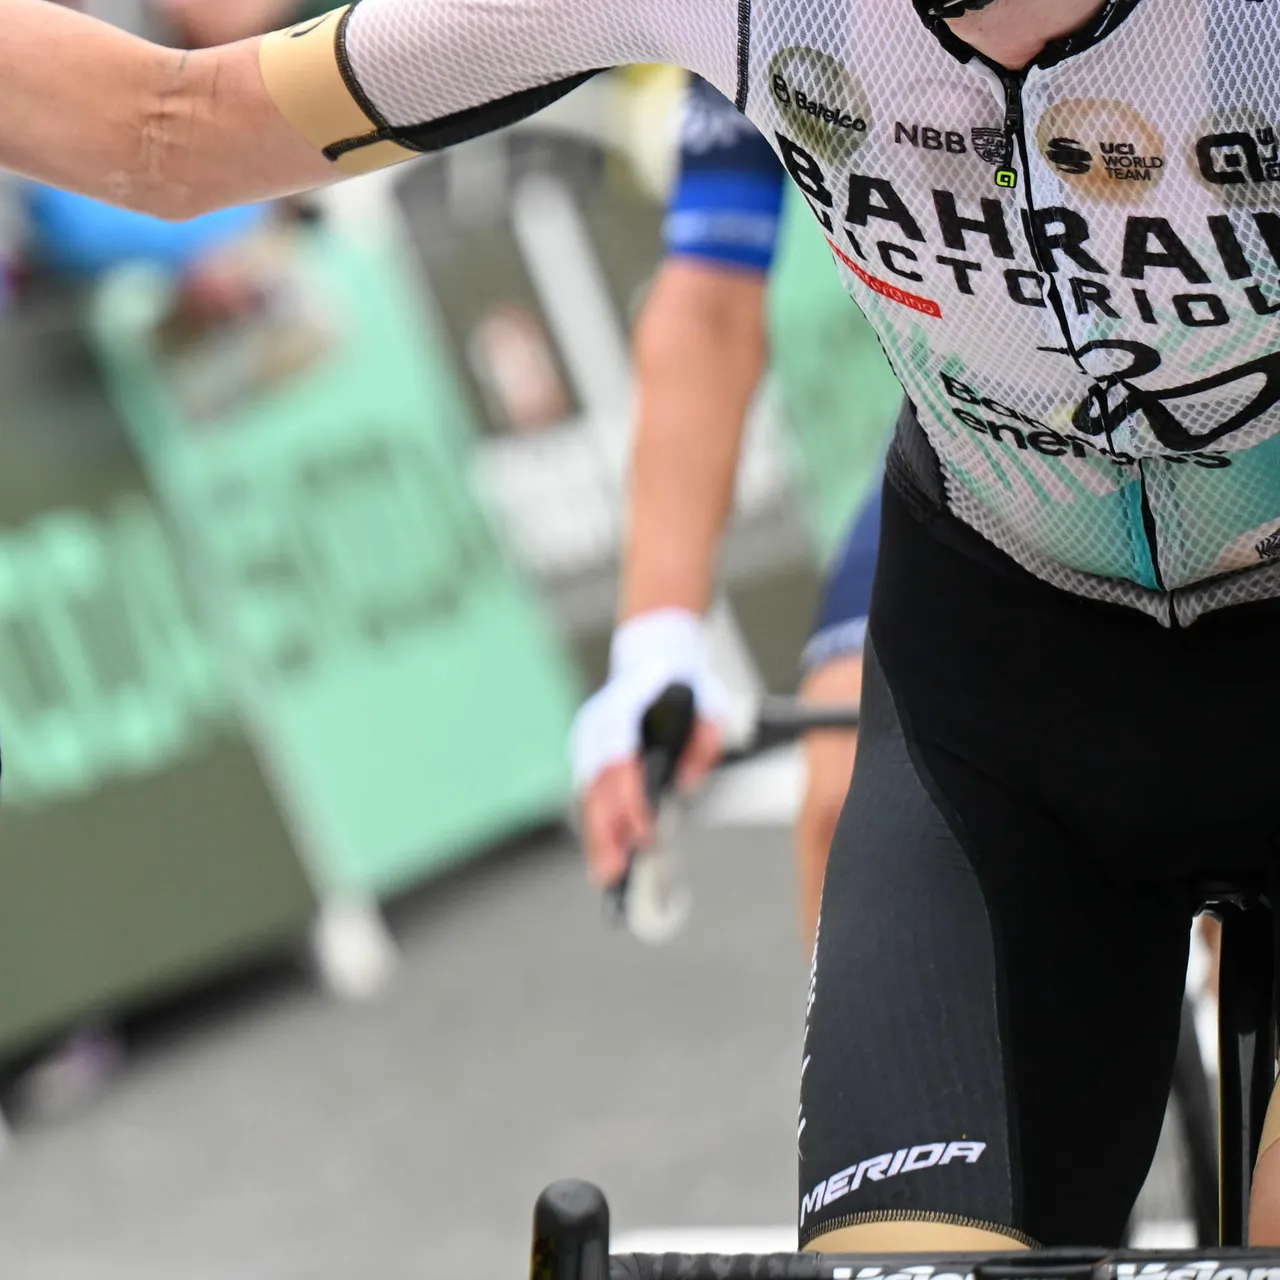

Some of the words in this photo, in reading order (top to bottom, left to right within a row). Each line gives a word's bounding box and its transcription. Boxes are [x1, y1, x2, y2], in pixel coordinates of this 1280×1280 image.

[795, 90, 867, 133] Batelco
[894, 121, 967, 154] NBB
[1099, 141, 1136, 156] UCI
[1101, 155, 1164, 170] WORLD
[1104, 167, 1153, 182] TEAM
[775, 130, 1280, 286] BAHRAI
[799, 1141, 987, 1228] MERIDA
